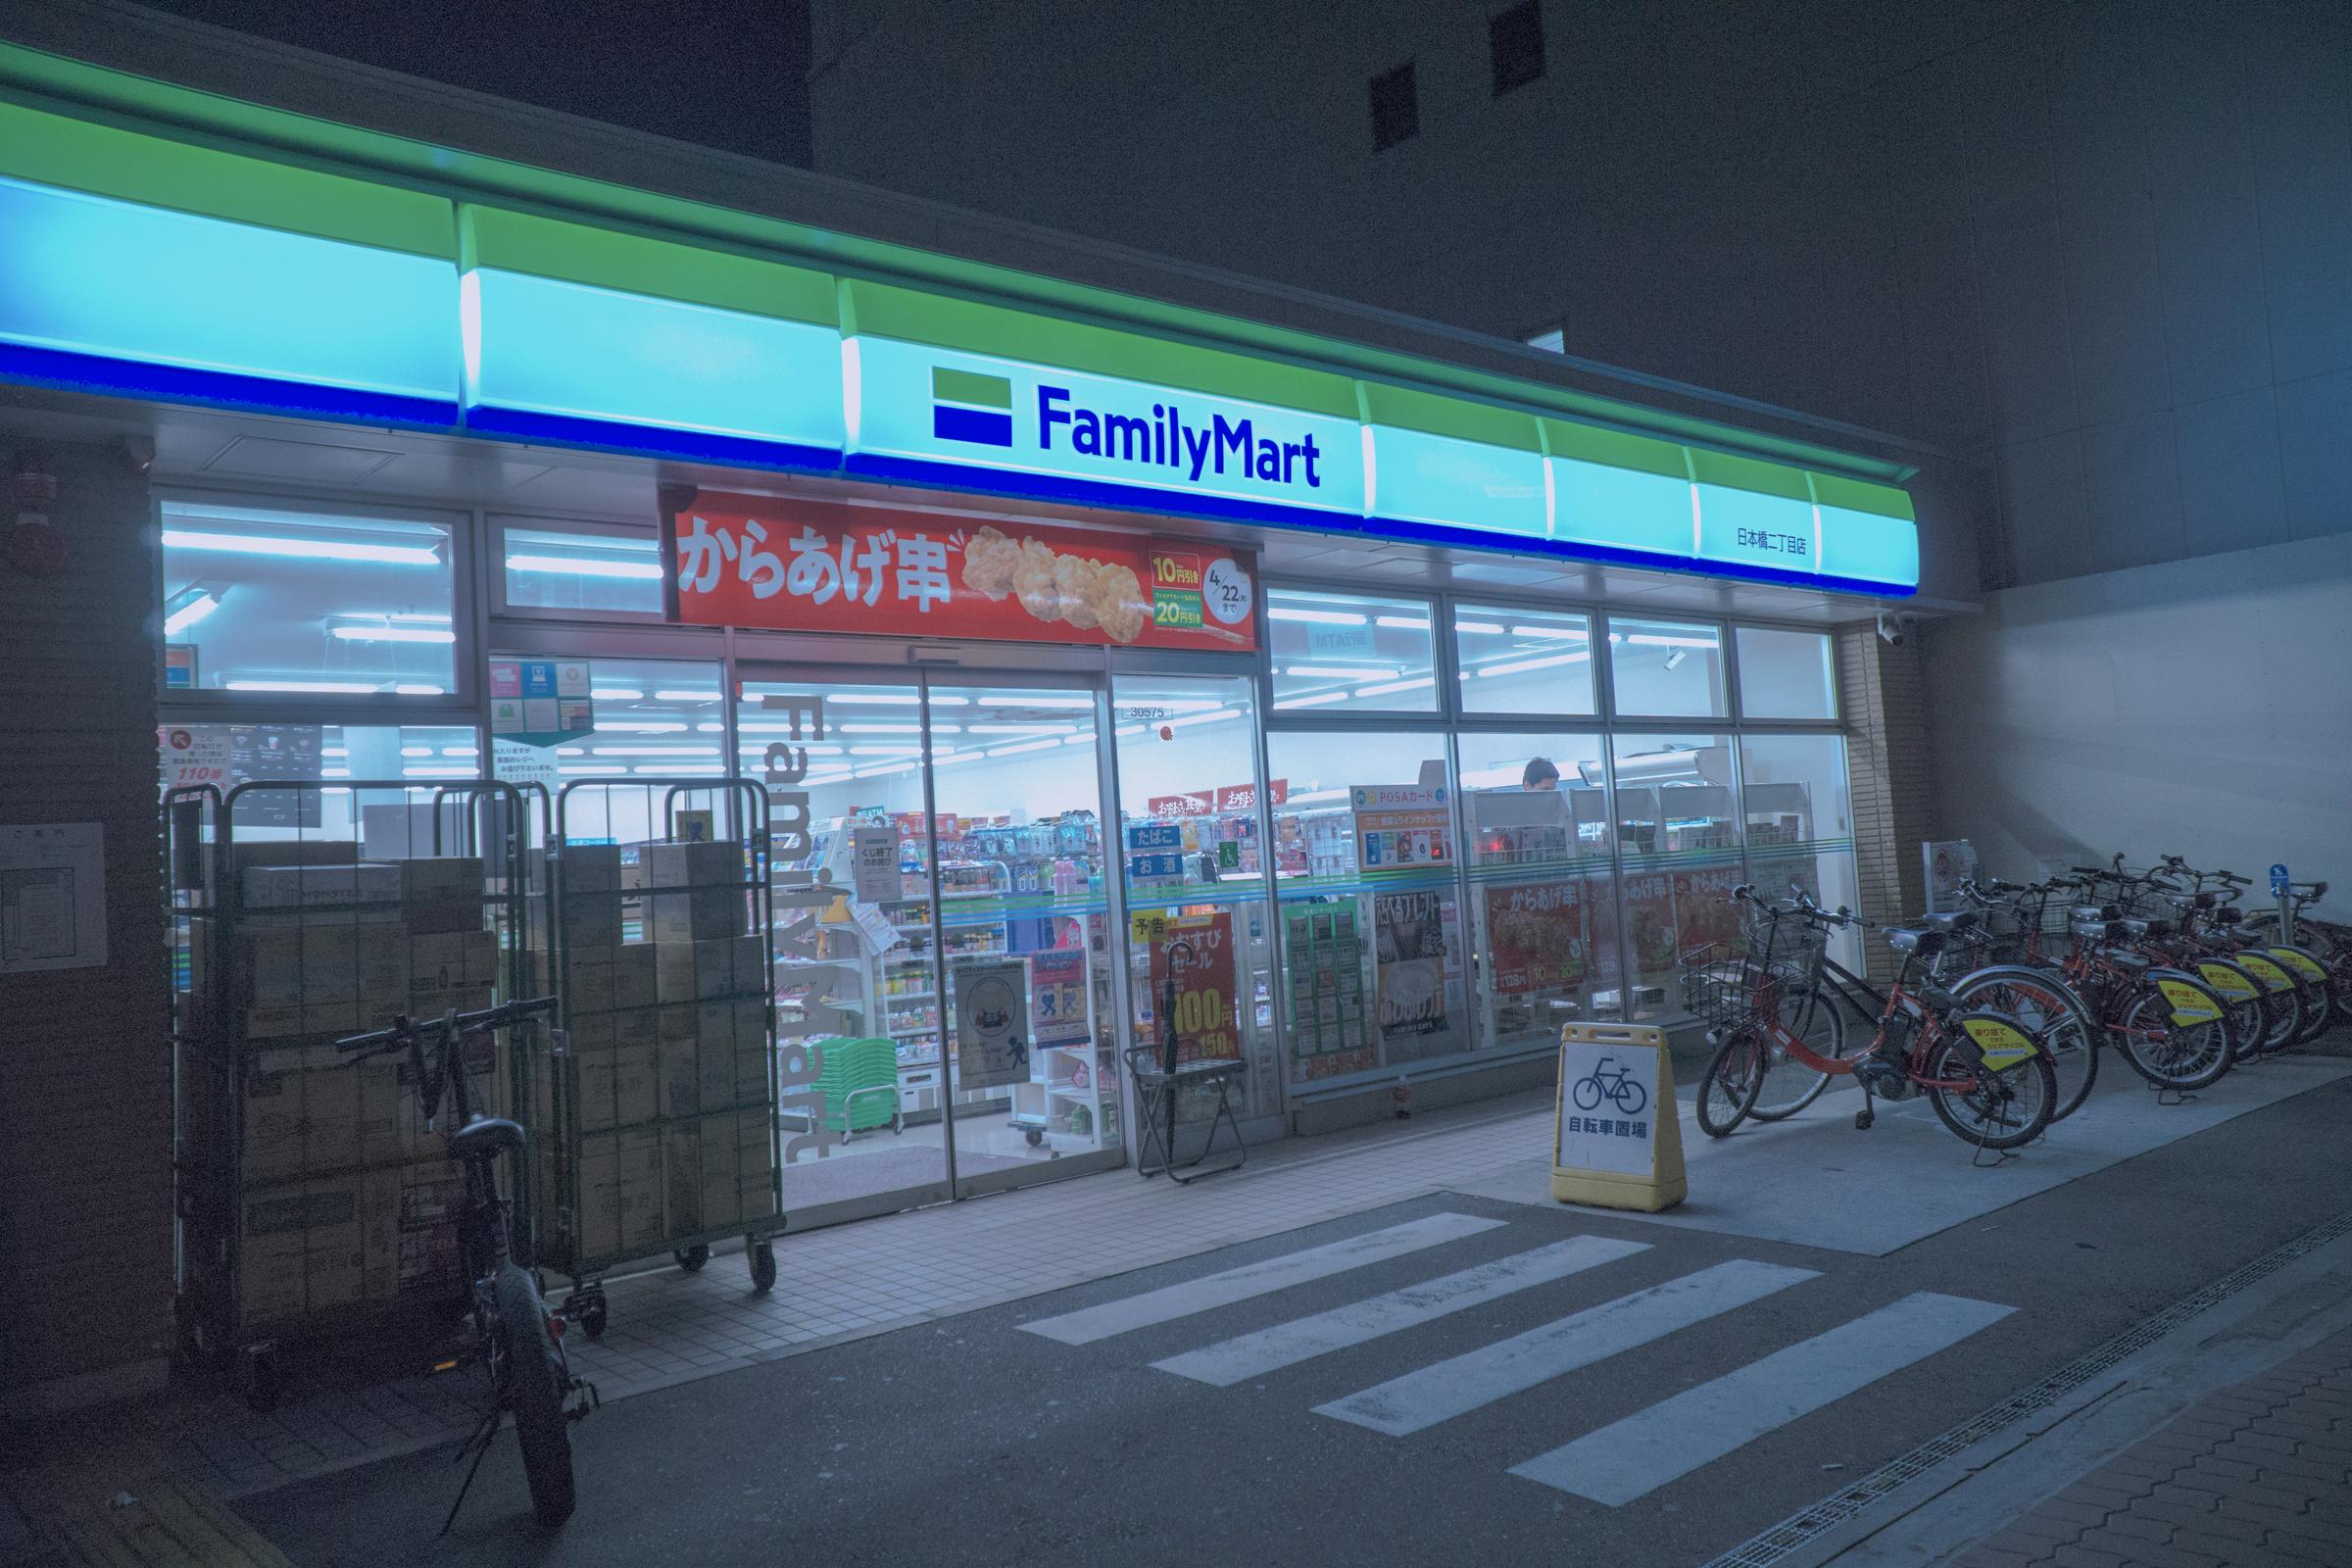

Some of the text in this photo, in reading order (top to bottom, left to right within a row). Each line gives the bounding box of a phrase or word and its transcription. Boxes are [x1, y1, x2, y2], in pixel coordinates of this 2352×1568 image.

[1038, 384, 1320, 487] FamilyMart
[1738, 527, 1806, 555] 日本橋二丁目店
[678, 516, 951, 612] からあげ串
[1152, 557, 1199, 584] 10円引き
[1156, 602, 1200, 623] 20円引き
[1130, 707, 1165, 717] 30575
[1379, 790, 1433, 803] POSAカード
[1137, 830, 1173, 846] たばこ
[861, 847, 893, 858] くじ終了
[1140, 858, 1176, 874] お酒
[1509, 884, 1577, 911] からあげ串
[761, 695, 840, 1163] FamilyMart
[1135, 916, 1165, 934] 予告
[1569, 1116, 1647, 1139] 自転車置場
